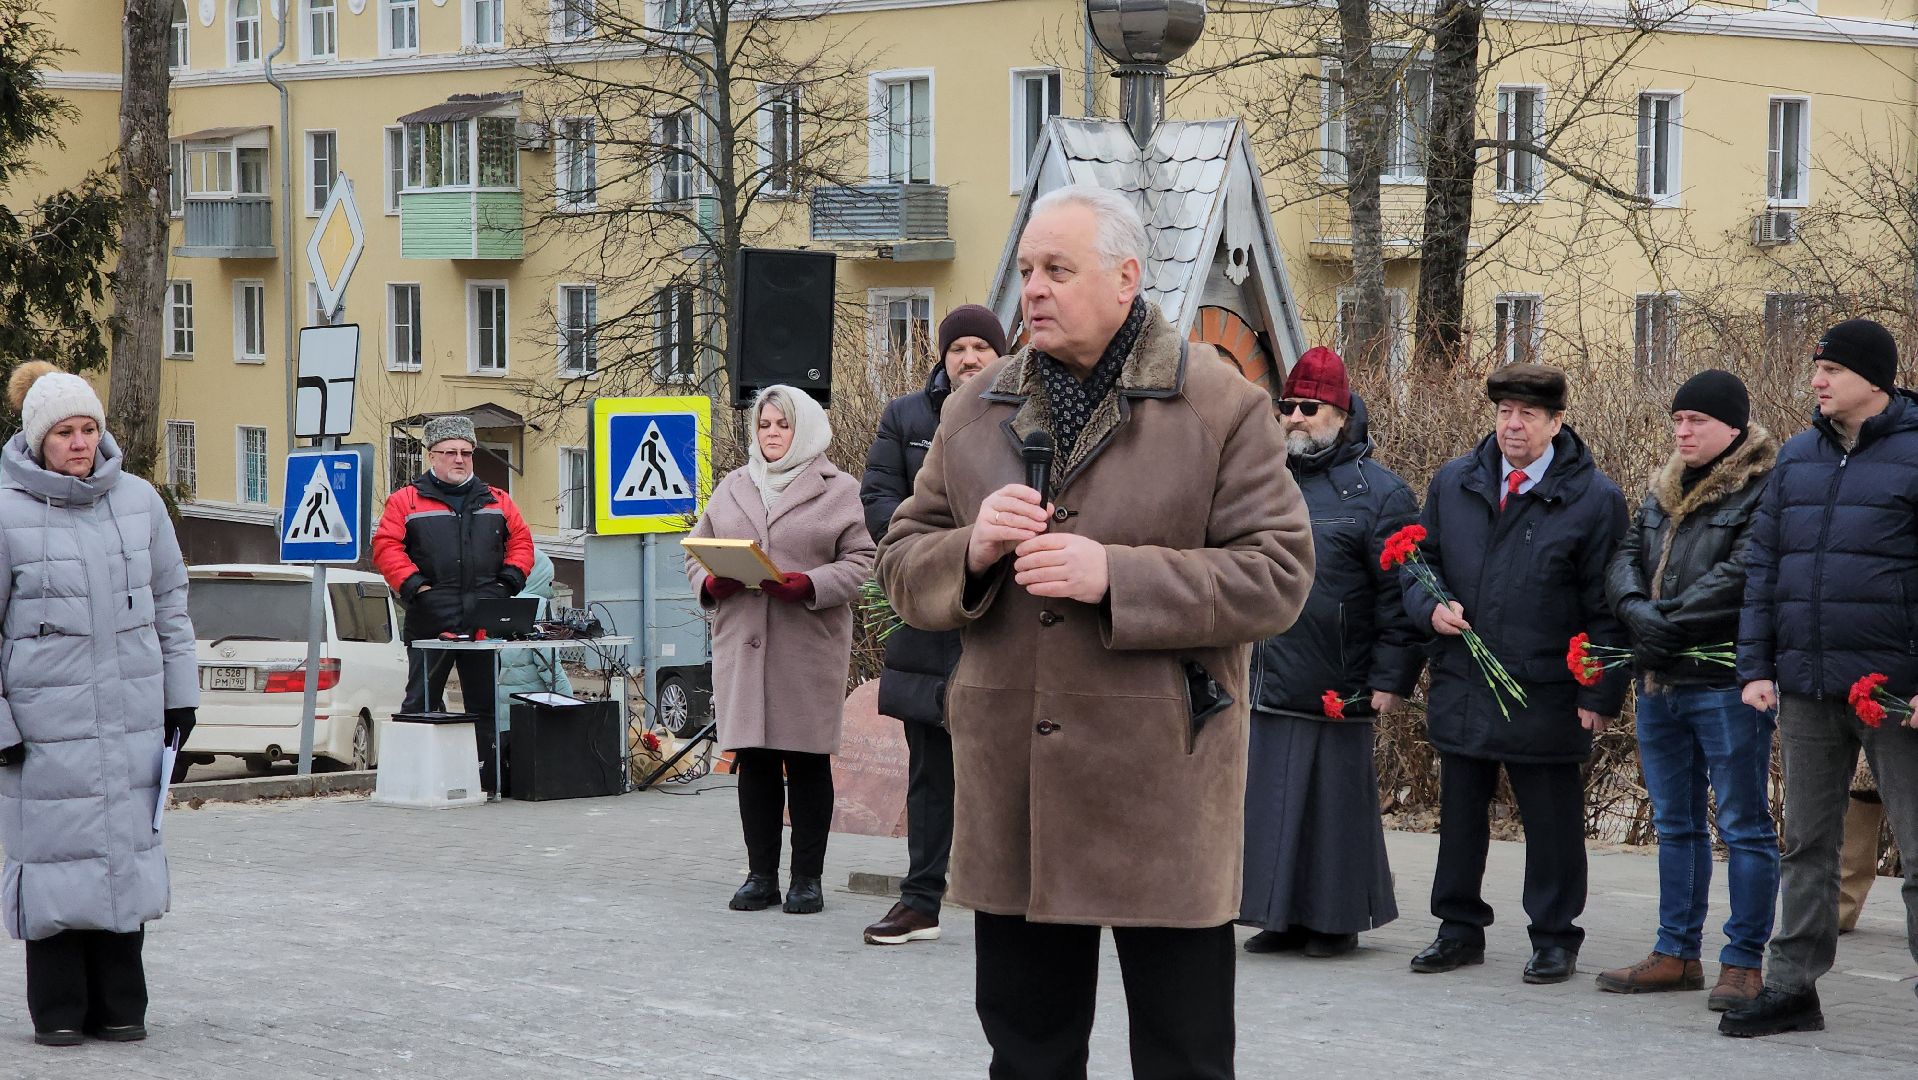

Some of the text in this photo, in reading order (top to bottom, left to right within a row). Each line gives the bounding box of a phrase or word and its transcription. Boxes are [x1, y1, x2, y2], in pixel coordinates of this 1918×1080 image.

[216, 668, 241, 677] С 528
[215, 678, 228, 687] РМ
